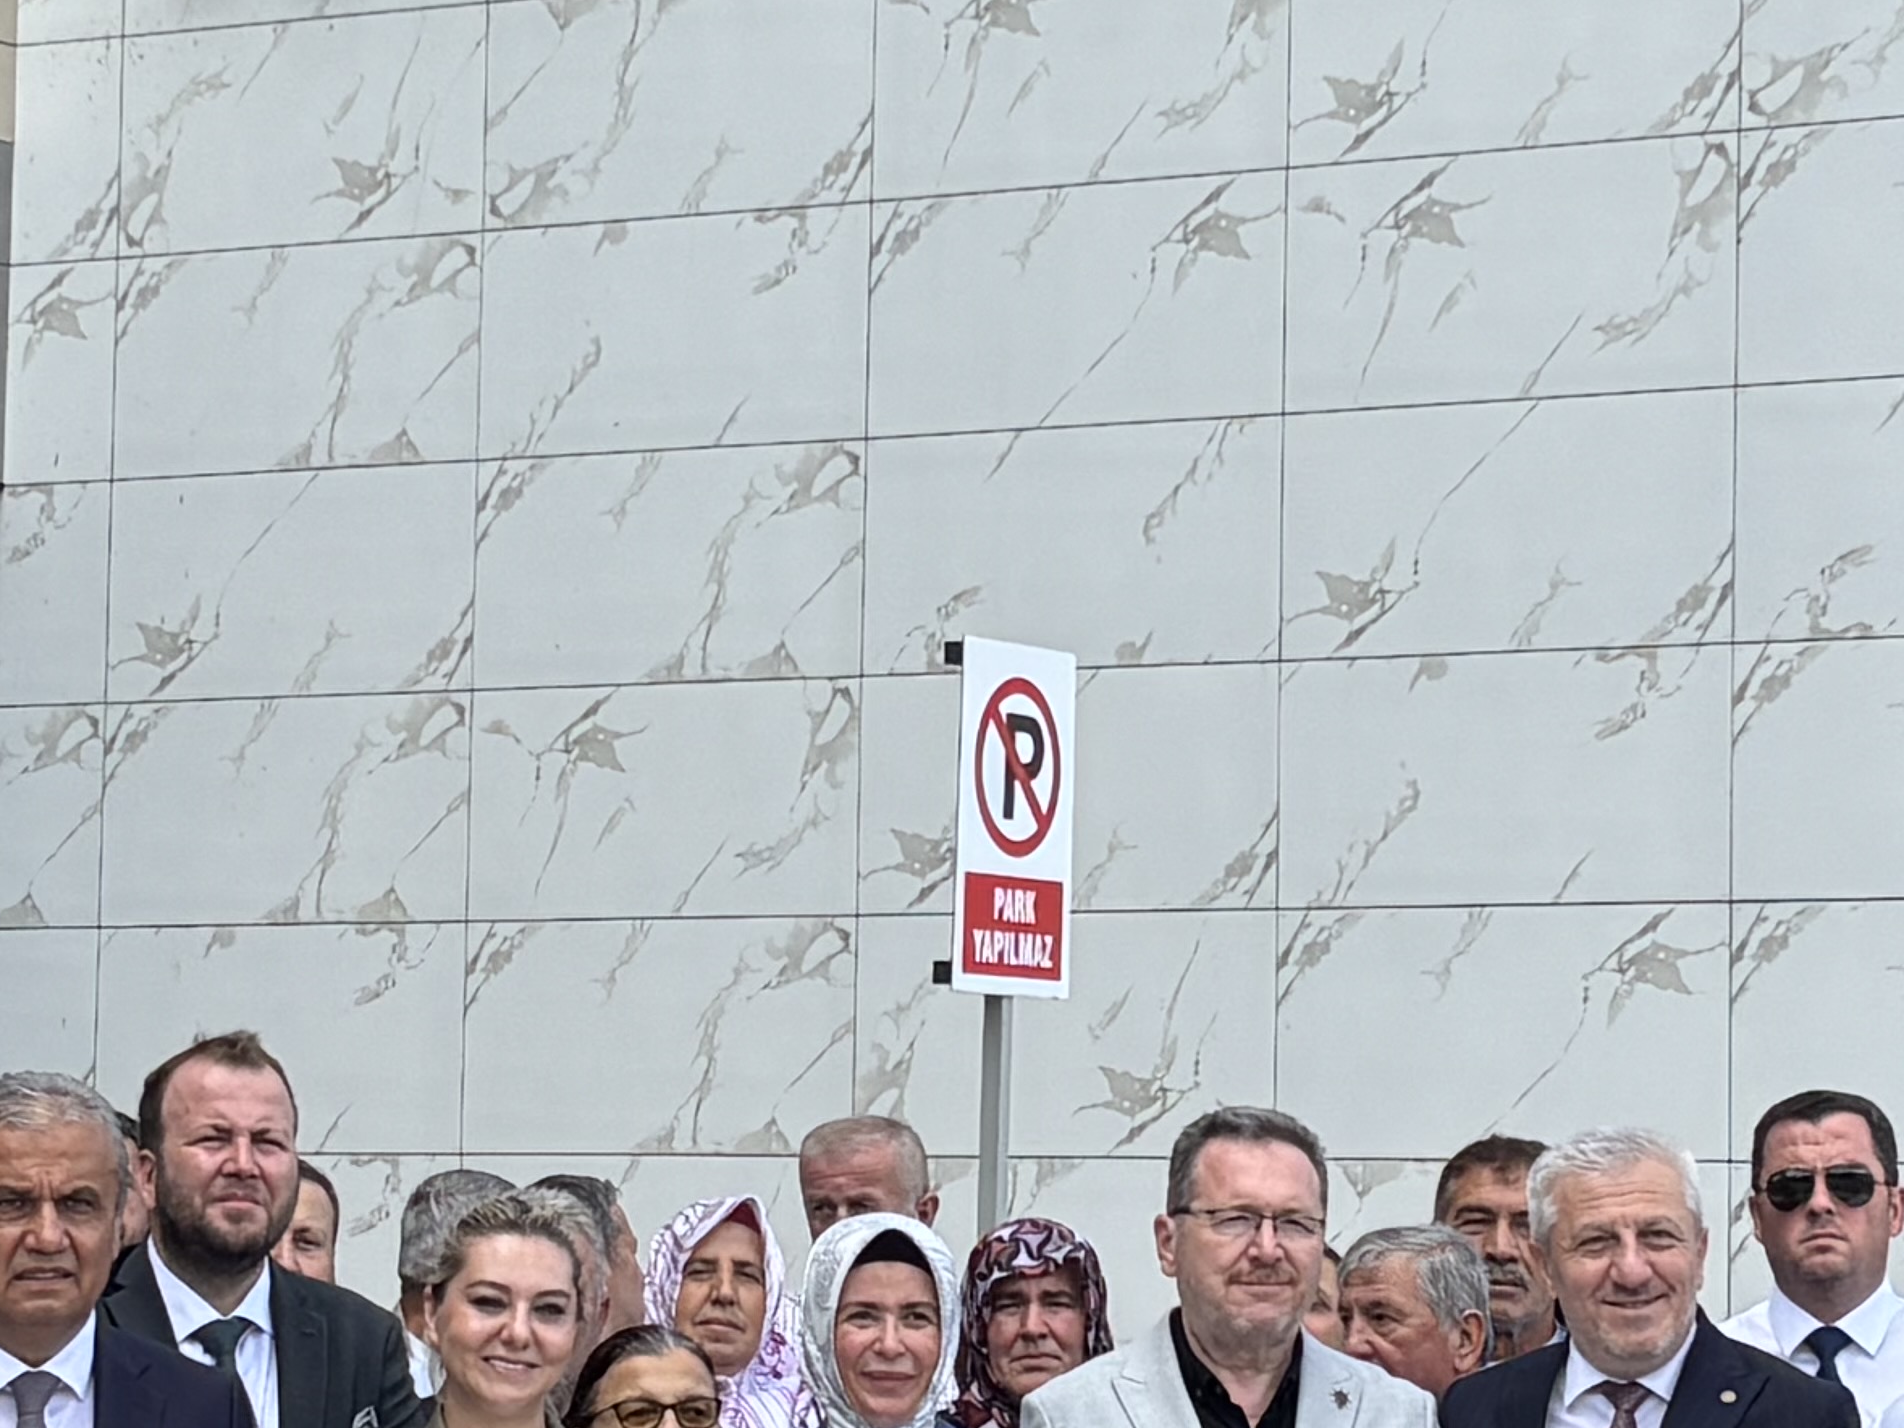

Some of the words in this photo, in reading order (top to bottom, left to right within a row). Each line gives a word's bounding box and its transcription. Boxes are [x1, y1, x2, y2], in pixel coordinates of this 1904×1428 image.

[1002, 712, 1045, 820] P
[993, 886, 1037, 925] PARK
[972, 928, 1054, 969] YAPILMAZ
